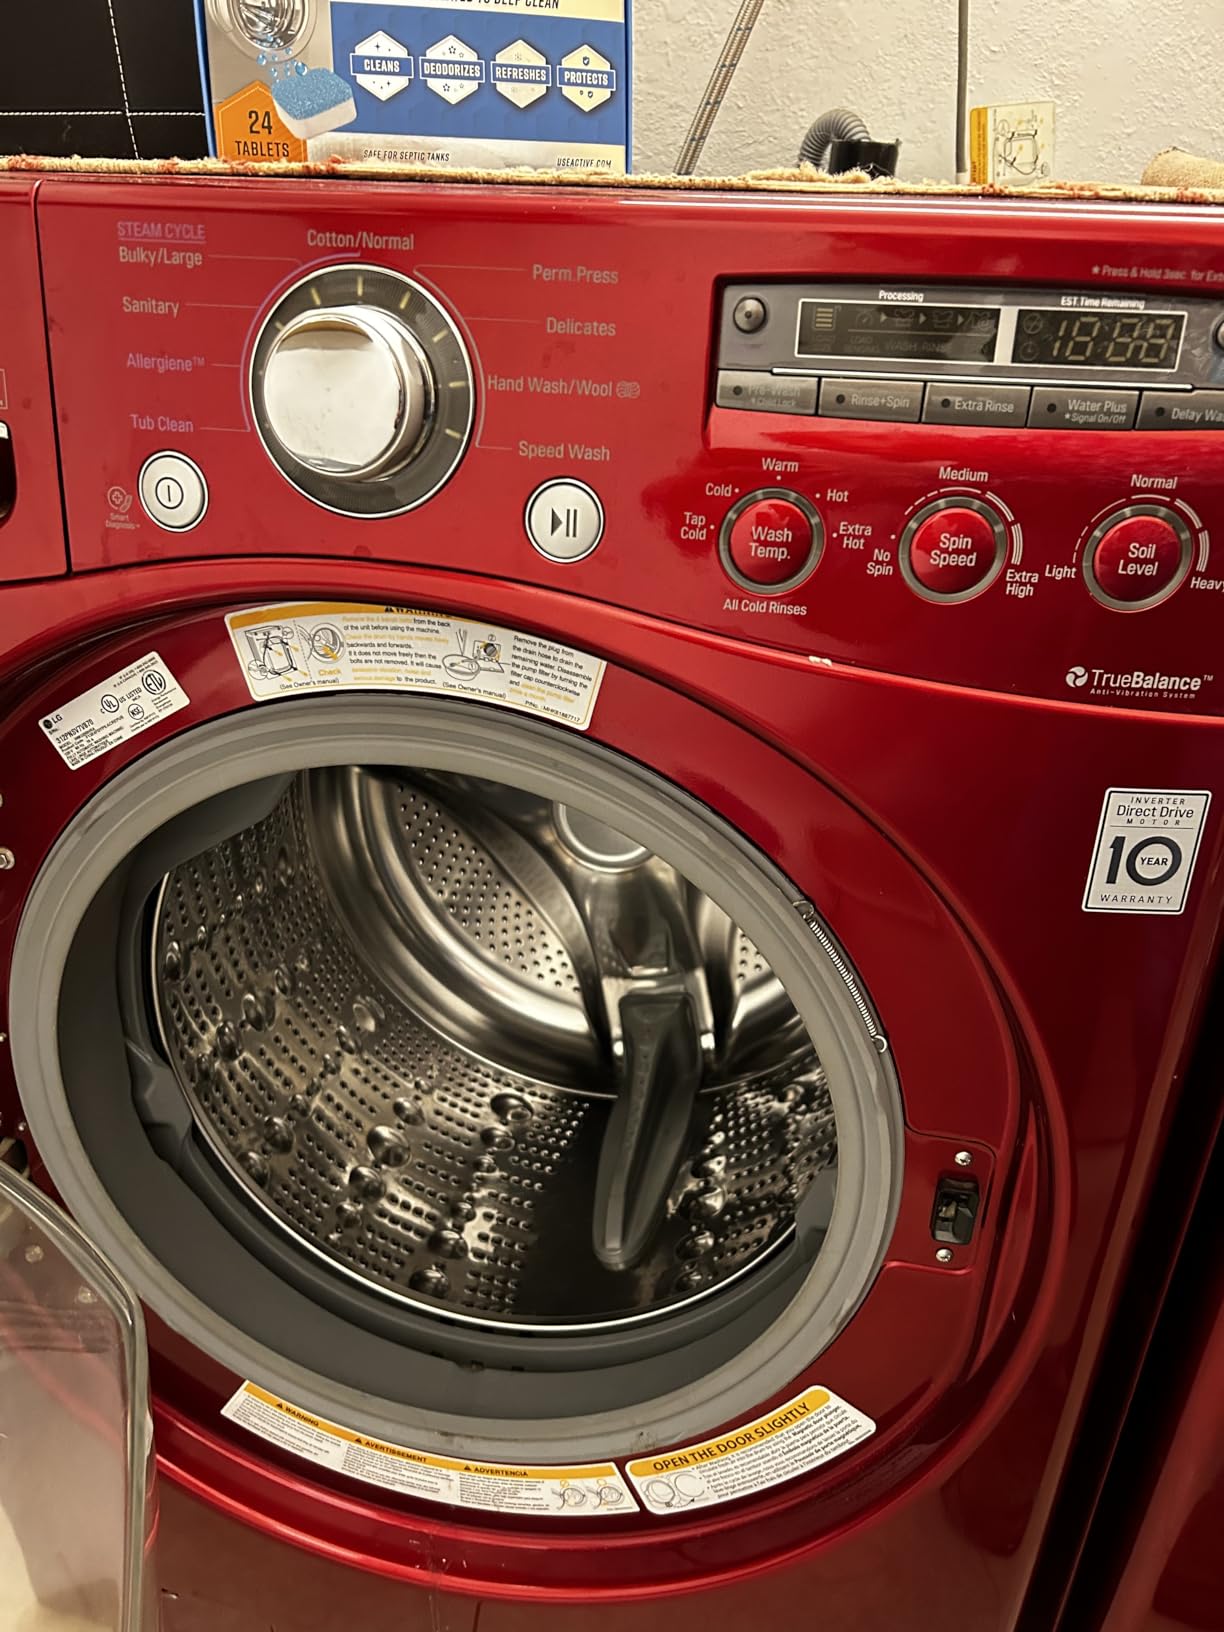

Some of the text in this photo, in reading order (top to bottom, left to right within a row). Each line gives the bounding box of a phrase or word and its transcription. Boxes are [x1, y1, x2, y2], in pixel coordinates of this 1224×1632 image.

[364, 59, 400, 72] CLEANS
[424, 63, 480, 77] DEODORIZES
[496, 67, 546, 80] REFRESHES
[564, 71, 608, 85] PROTECTS
[248, 110, 272, 134] 24
[235, 141, 289, 157] TABLETS
[364, 150, 450, 162] SAFE FOR SEPTIC TANKS
[118, 222, 205, 239] STEAM CYCLE
[307, 230, 414, 250] Cotton/Normal
[119, 246, 202, 268] Bulky/Large
[577, 266, 618, 284] Press
[1102, 265, 1128, 277] Press
[1130, 267, 1138, 277] &
[1140, 267, 1161, 279] Hold
[1191, 270, 1203, 280] for
[879, 290, 924, 303] Processing
[1080, 297, 1100, 307] Time
[1101, 298, 1145, 310] Remaining
[123, 297, 179, 318] Sanitary
[547, 317, 616, 336] Delicates
[488, 375, 612, 397] Hand Wash/Wool
[851, 394, 910, 409] Rinse+Spin
[954, 399, 1014, 413] Extra Rinse
[1068, 400, 1127, 413] Water Plus
[130, 413, 194, 432] Tub Clean
[1072, 413, 1127, 424] Signal On/Off
[1171, 408, 1202, 422] Delay
[519, 441, 610, 461] Speed Wash
[762, 458, 799, 472] Warm
[939, 466, 989, 482] Medium
[1131, 474, 1178, 489] Normal
[705, 483, 732, 497] Cold
[827, 489, 849, 502] Hot
[684, 512, 706, 527] Tap
[680, 527, 707, 540] Cold
[751, 526, 792, 542] Wash
[839, 522, 872, 536] Extra
[843, 537, 864, 550] Hot
[940, 533, 972, 551] Spin
[749, 543, 791, 562] Temp.
[873, 549, 891, 562] No
[1128, 543, 1156, 559] Soil
[930, 550, 977, 568] Speed
[867, 562, 893, 577] Spin
[1045, 565, 1077, 580] Light
[1118, 560, 1159, 576] Level
[1006, 570, 1039, 583] Extra
[1006, 583, 1034, 598] High
[723, 599, 807, 615] All Cold Rinses
[513, 634, 574, 657] Remove the plug from
[512, 644, 521, 652] the
[522, 647, 536, 656] drain
[537, 651, 551, 660] hose
[558, 657, 573, 666] drain
[510, 661, 588, 689] the pump filter by turning the
[511, 653, 592, 682] remaining Disassemble
[280, 682, 293, 690] (See
[508, 678, 520, 686] and
[510, 669, 522, 678] filter
[522, 673, 534, 682] cap
[533, 677, 581, 696] counterclockwise
[442, 681, 457, 691] (See
[483, 688, 507, 699] manual)
[1090, 688, 1158, 697] Anti-Vibration
[51, 714, 63, 724] LG
[1130, 797, 1186, 805] INVERTER
[1117, 805, 1194, 818] Direct Drive
[1106, 836, 1182, 886] 10
[1140, 857, 1168, 866] YEAR
[1100, 894, 1173, 904] WARRANTY
[285, 1406, 319, 1427] WARNING
[653, 1455, 690, 1471] OPEN
[689, 1447, 717, 1462] THE
[716, 1433, 756, 1453] DOOR
[754, 1402, 810, 1437] SLIGHTLY
[365, 1440, 427, 1463] AVERTISSEMENT
[474, 1466, 528, 1476] ADVERTENCIA
